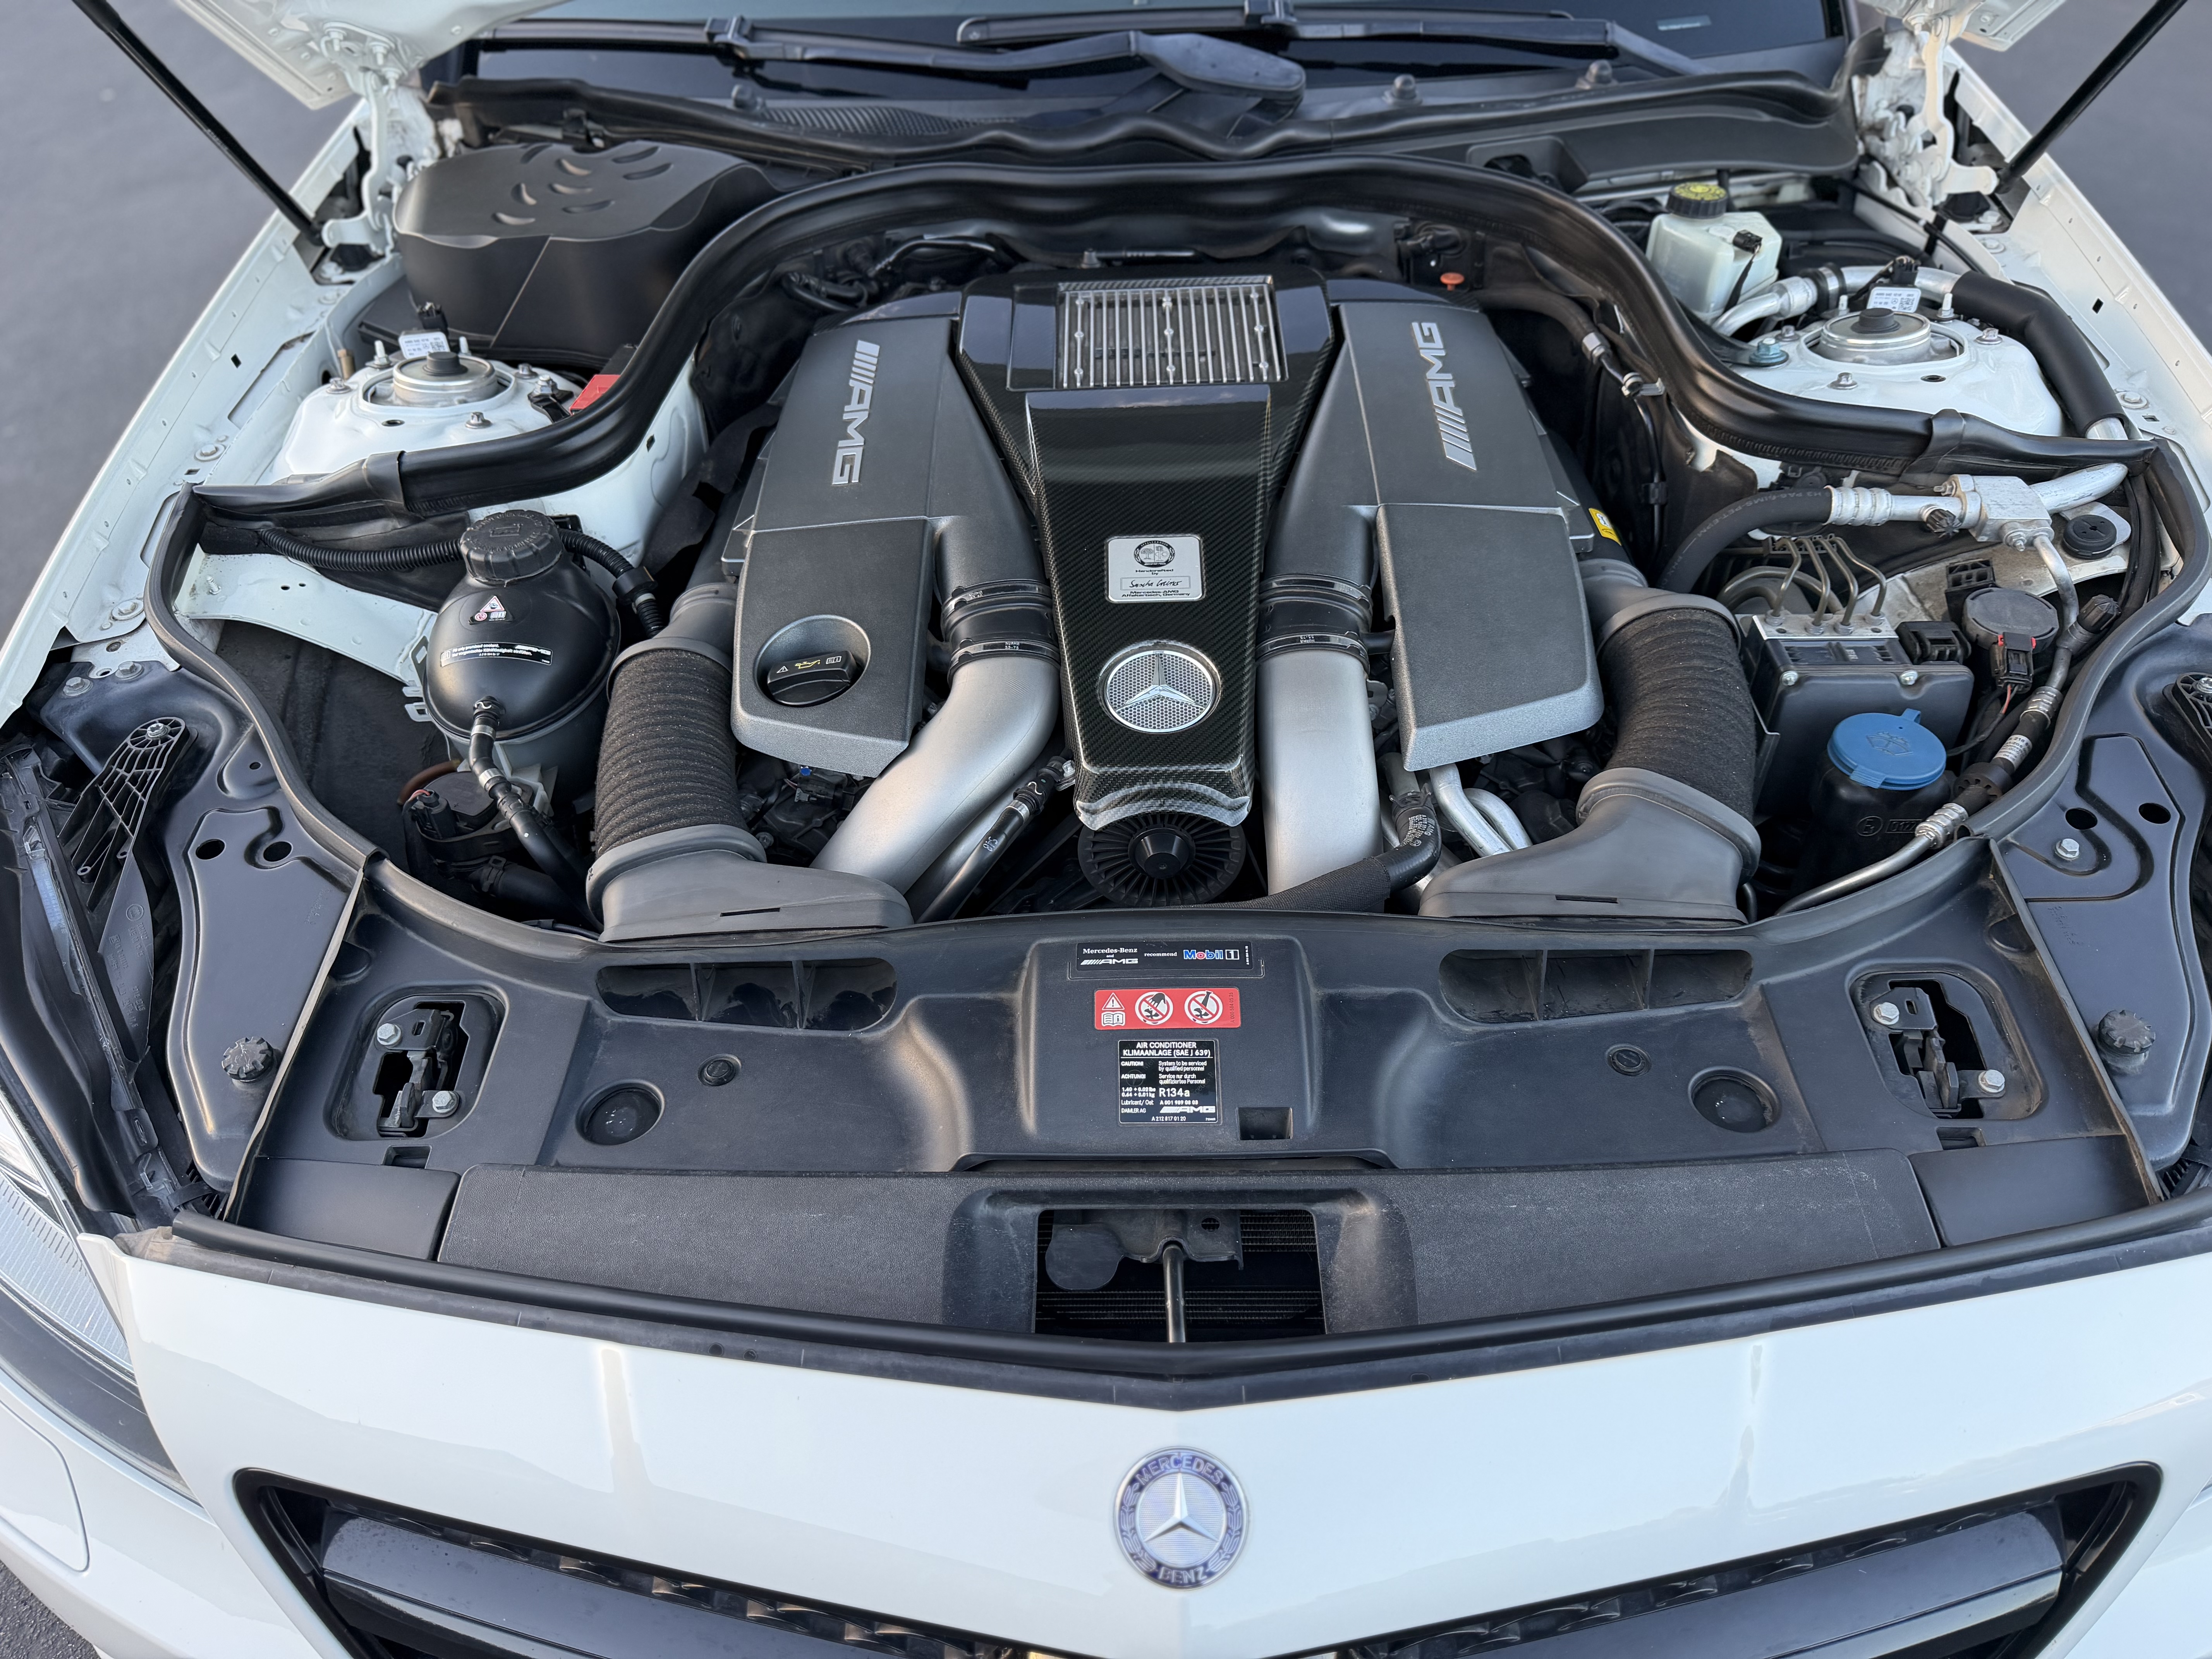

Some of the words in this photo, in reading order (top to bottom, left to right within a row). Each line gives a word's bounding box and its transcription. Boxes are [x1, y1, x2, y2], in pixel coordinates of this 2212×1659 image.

[1412, 322, 1463, 416] AMG
[832, 379, 872, 484] AMG
[1183, 950, 1223, 960] Mobil
[1159, 1088, 1190, 1097] R134a
[1135, 1455, 1224, 1486] MERCEDES
[1158, 1566, 1207, 1584] BENZ
